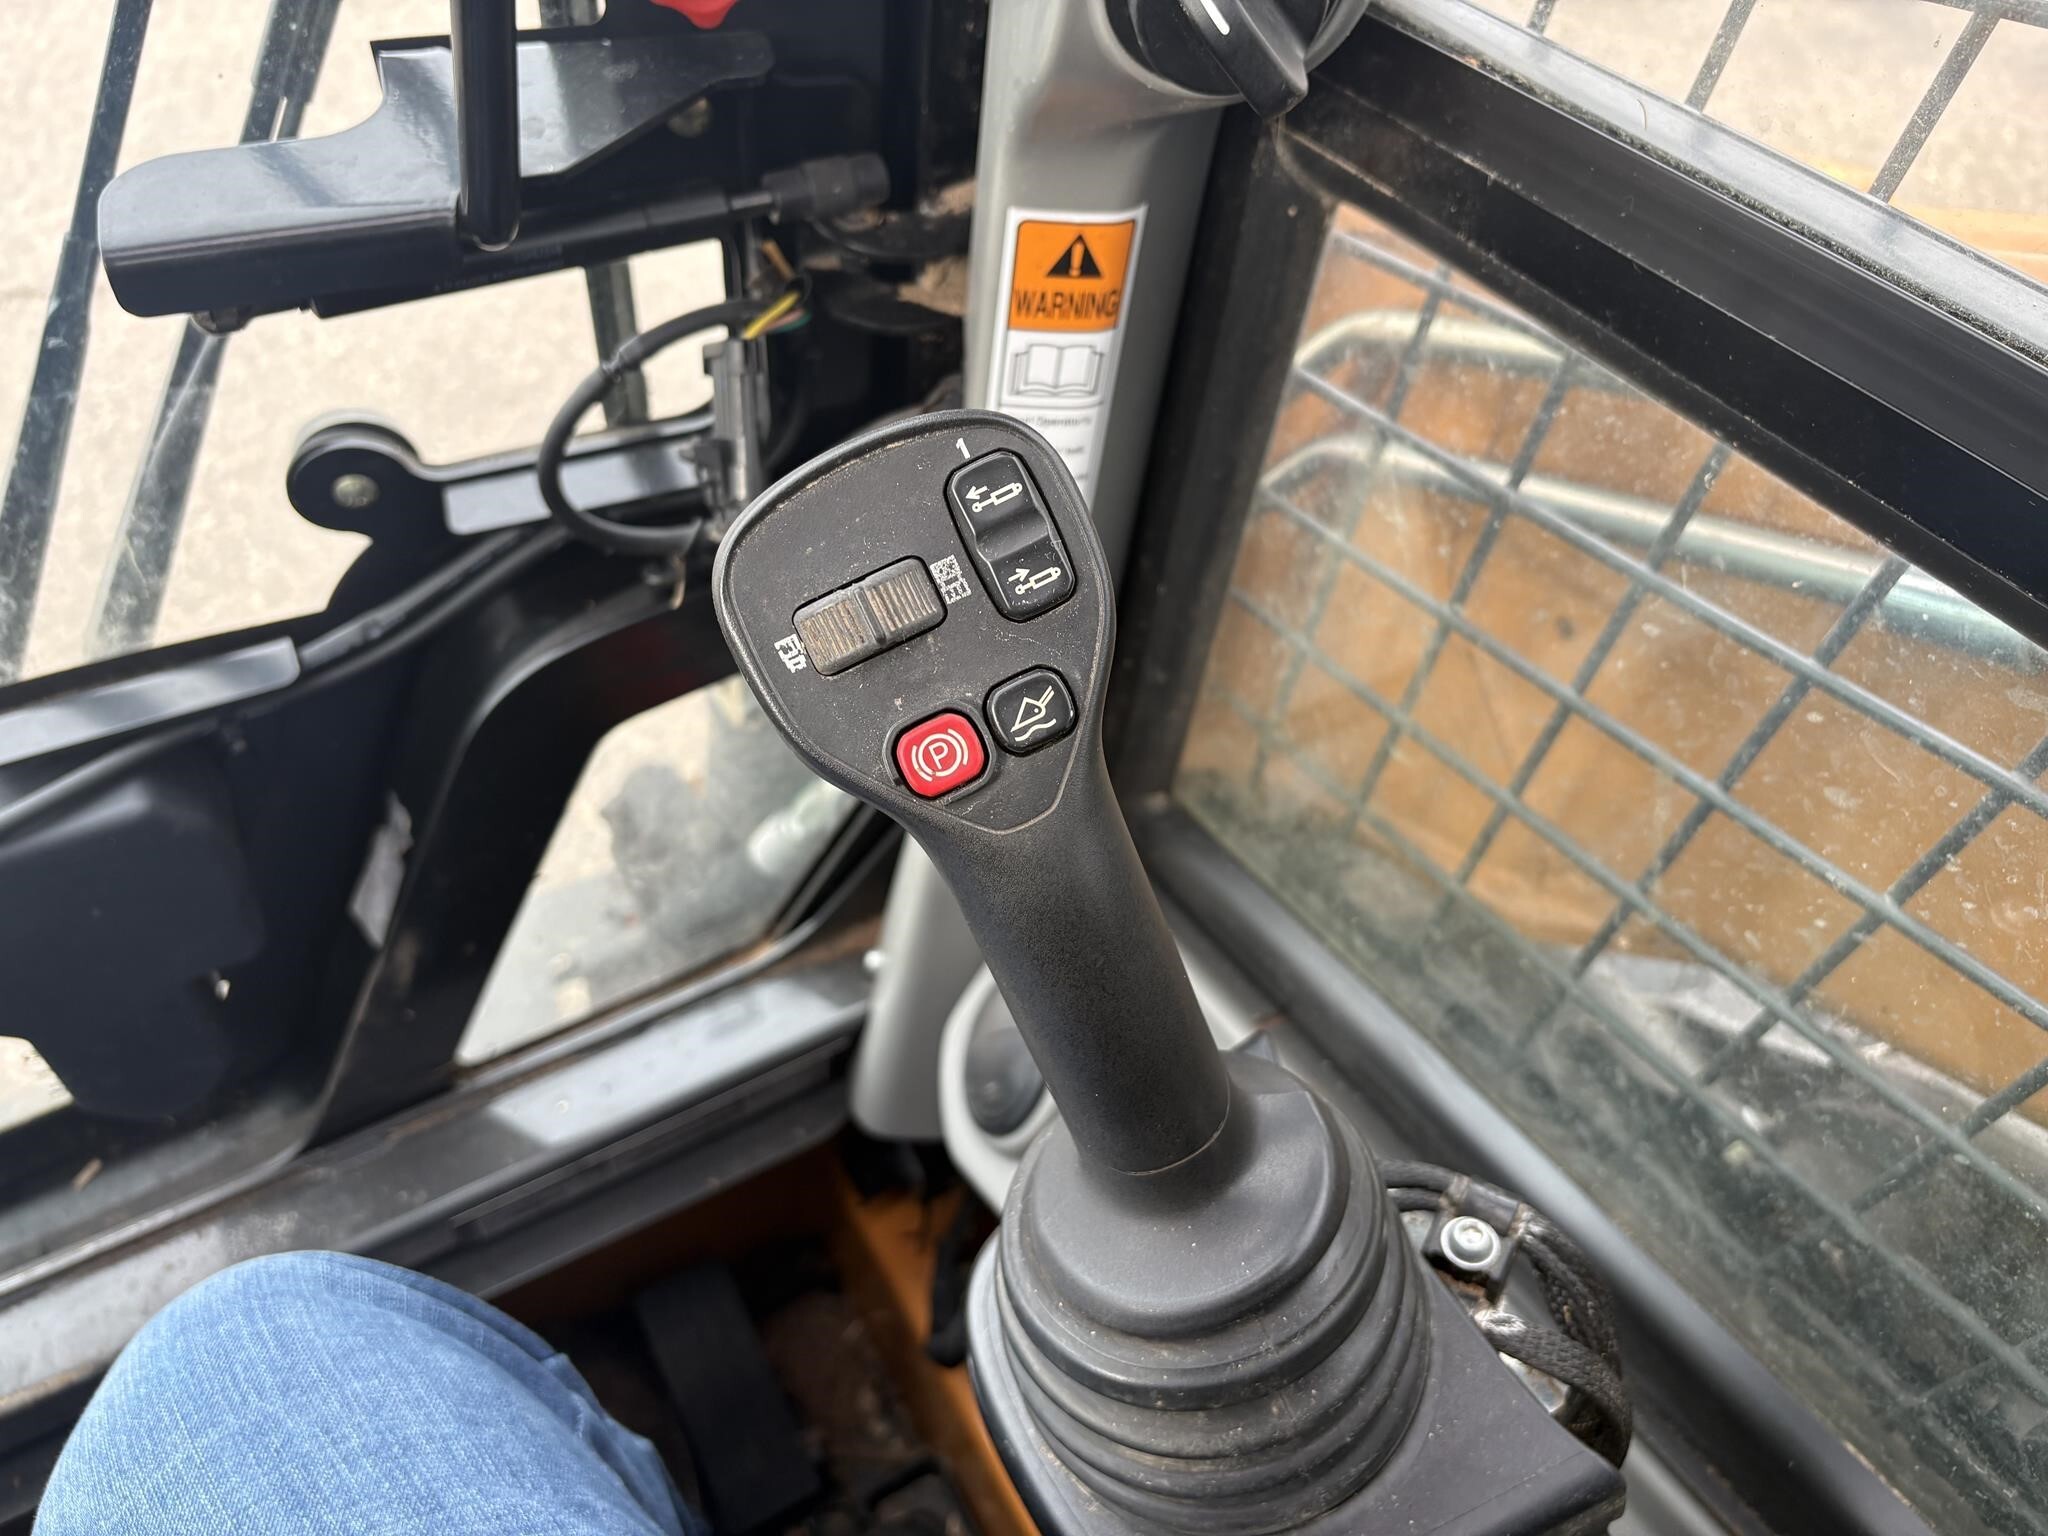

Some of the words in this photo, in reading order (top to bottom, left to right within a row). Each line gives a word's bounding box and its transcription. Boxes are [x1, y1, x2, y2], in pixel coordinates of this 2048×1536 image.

[1013, 289, 1120, 319] WARNING
[955, 437, 971, 460] 1
[928, 741, 949, 770] P
